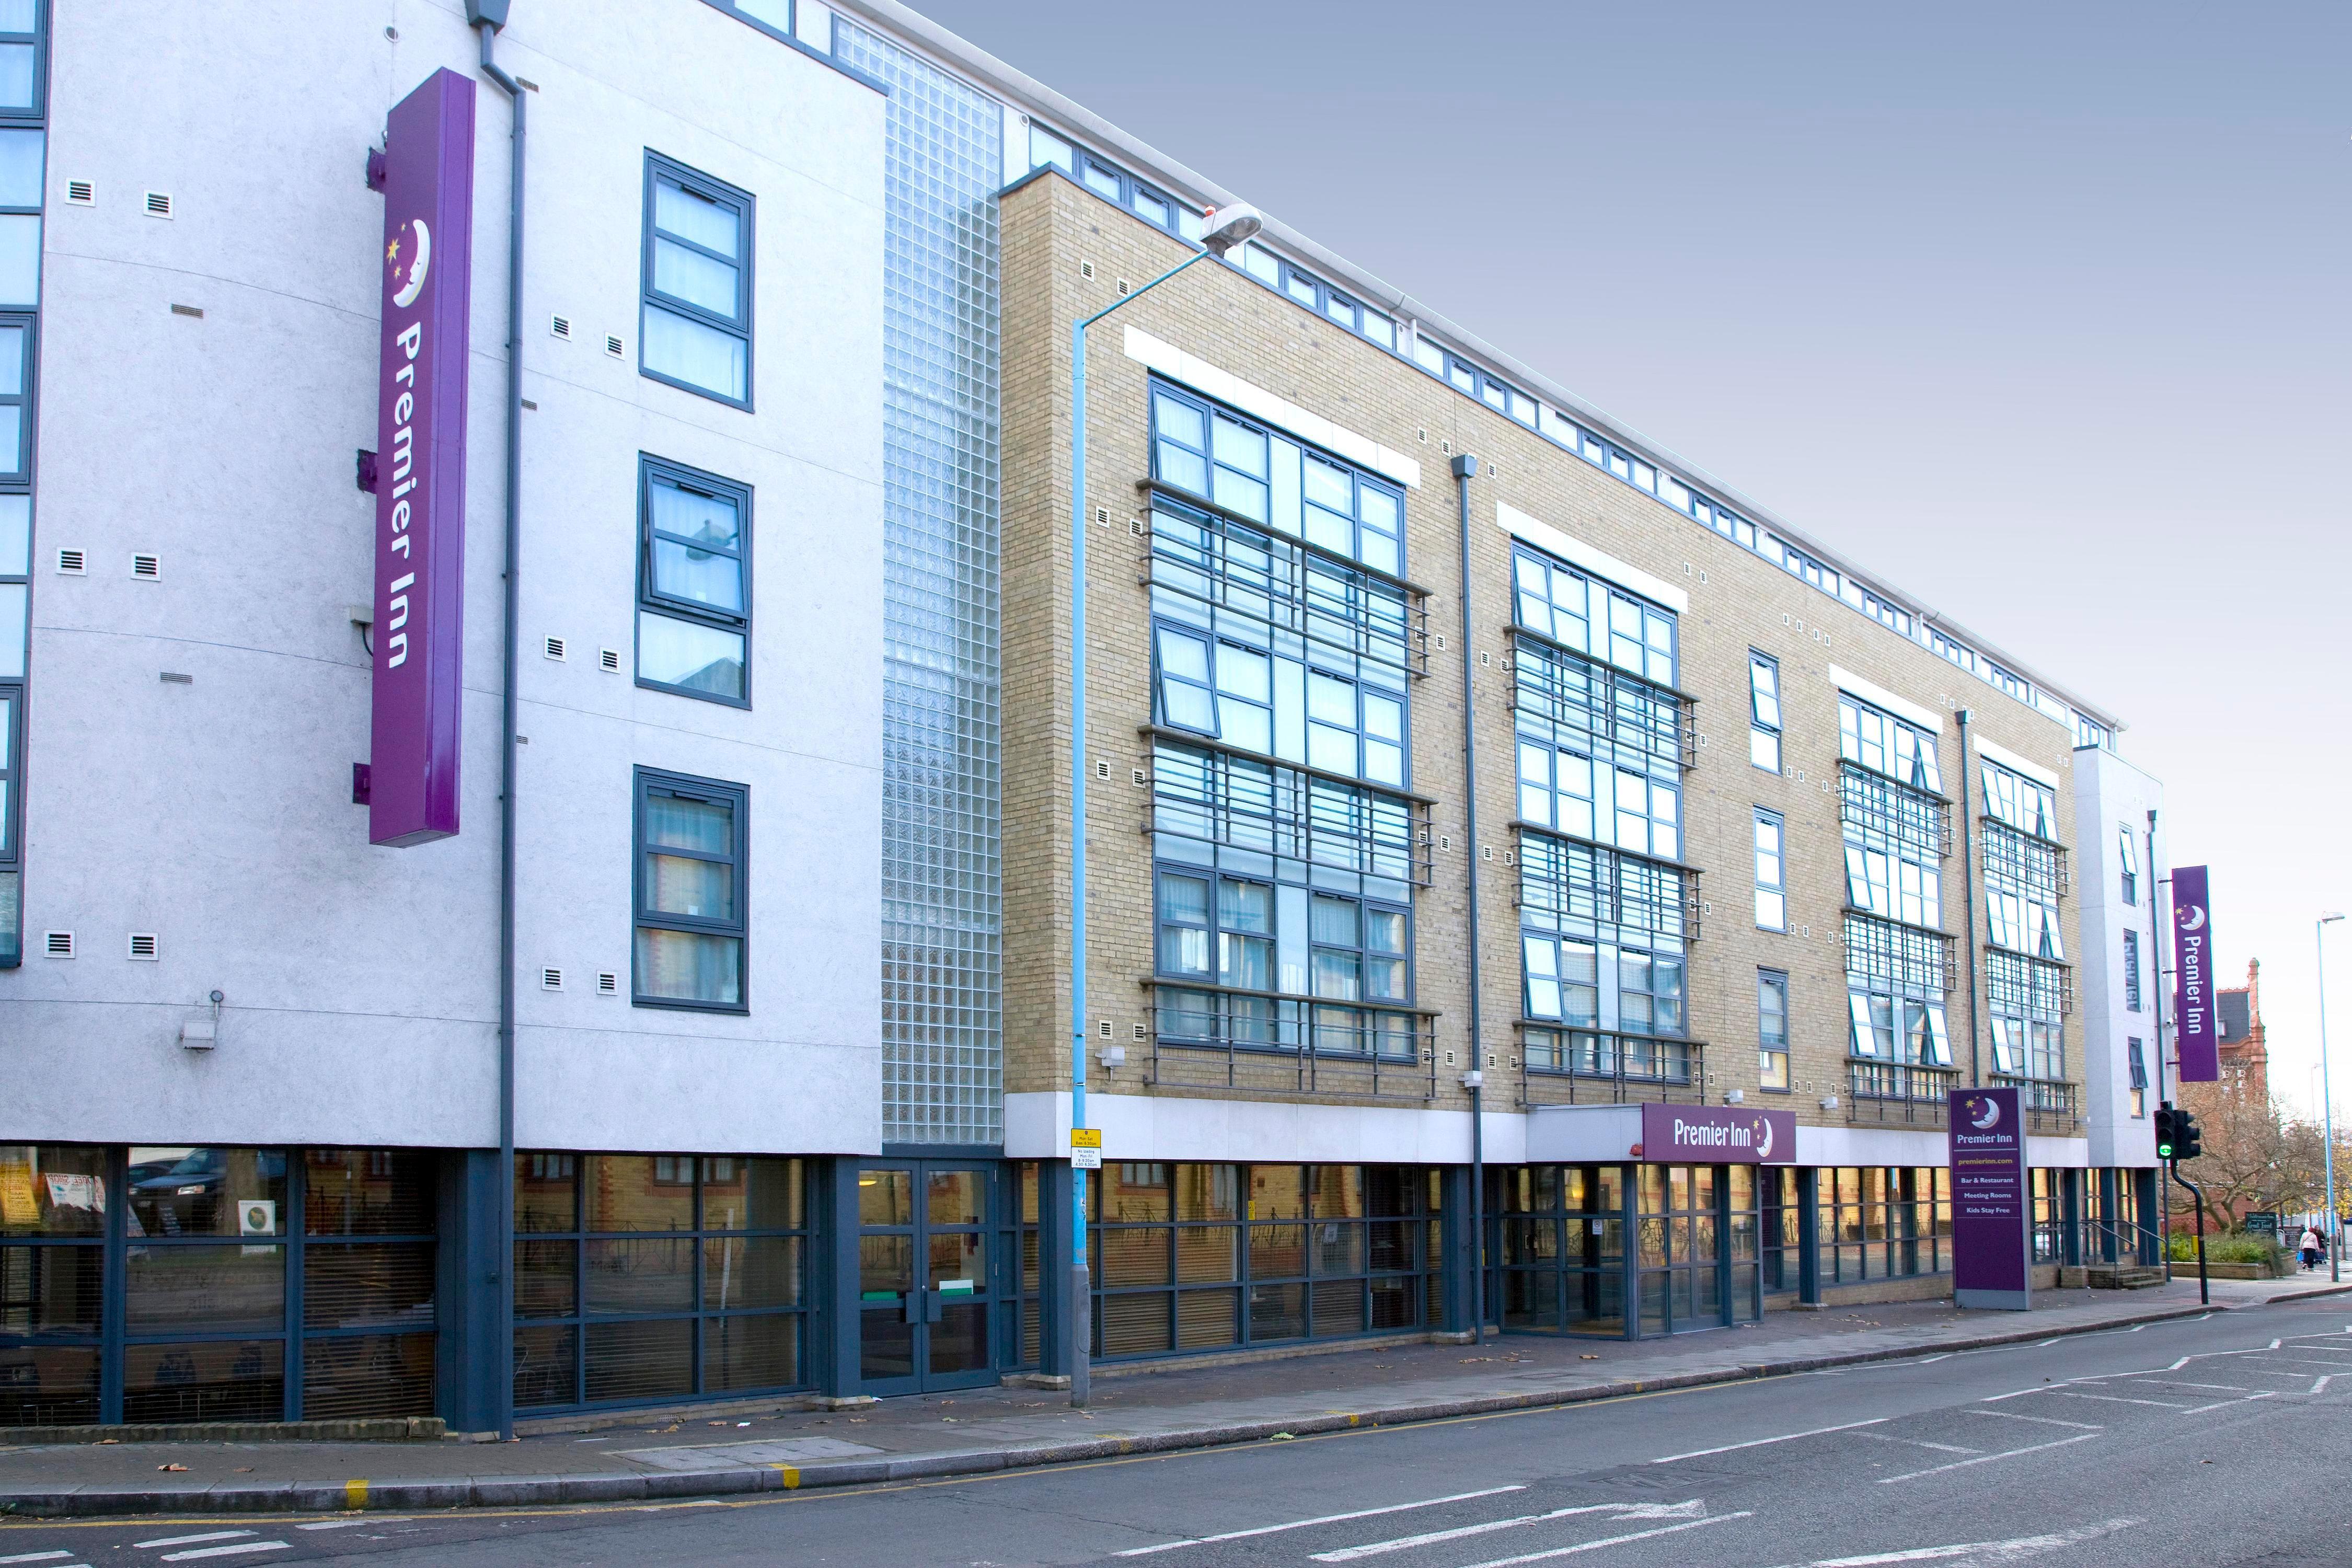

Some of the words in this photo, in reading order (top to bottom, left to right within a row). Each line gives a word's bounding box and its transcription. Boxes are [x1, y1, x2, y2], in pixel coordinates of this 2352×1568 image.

[391, 321, 421, 559] Premier
[388, 571, 414, 669] Inn
[2184, 936, 2203, 1004] Premier
[2187, 1007, 2204, 1034] Inn
[1675, 1119, 1728, 1146] Premier
[1731, 1121, 1750, 1147] Inn
[1957, 1134, 1996, 1144] Premier
[1997, 1133, 2012, 1143] Inn
